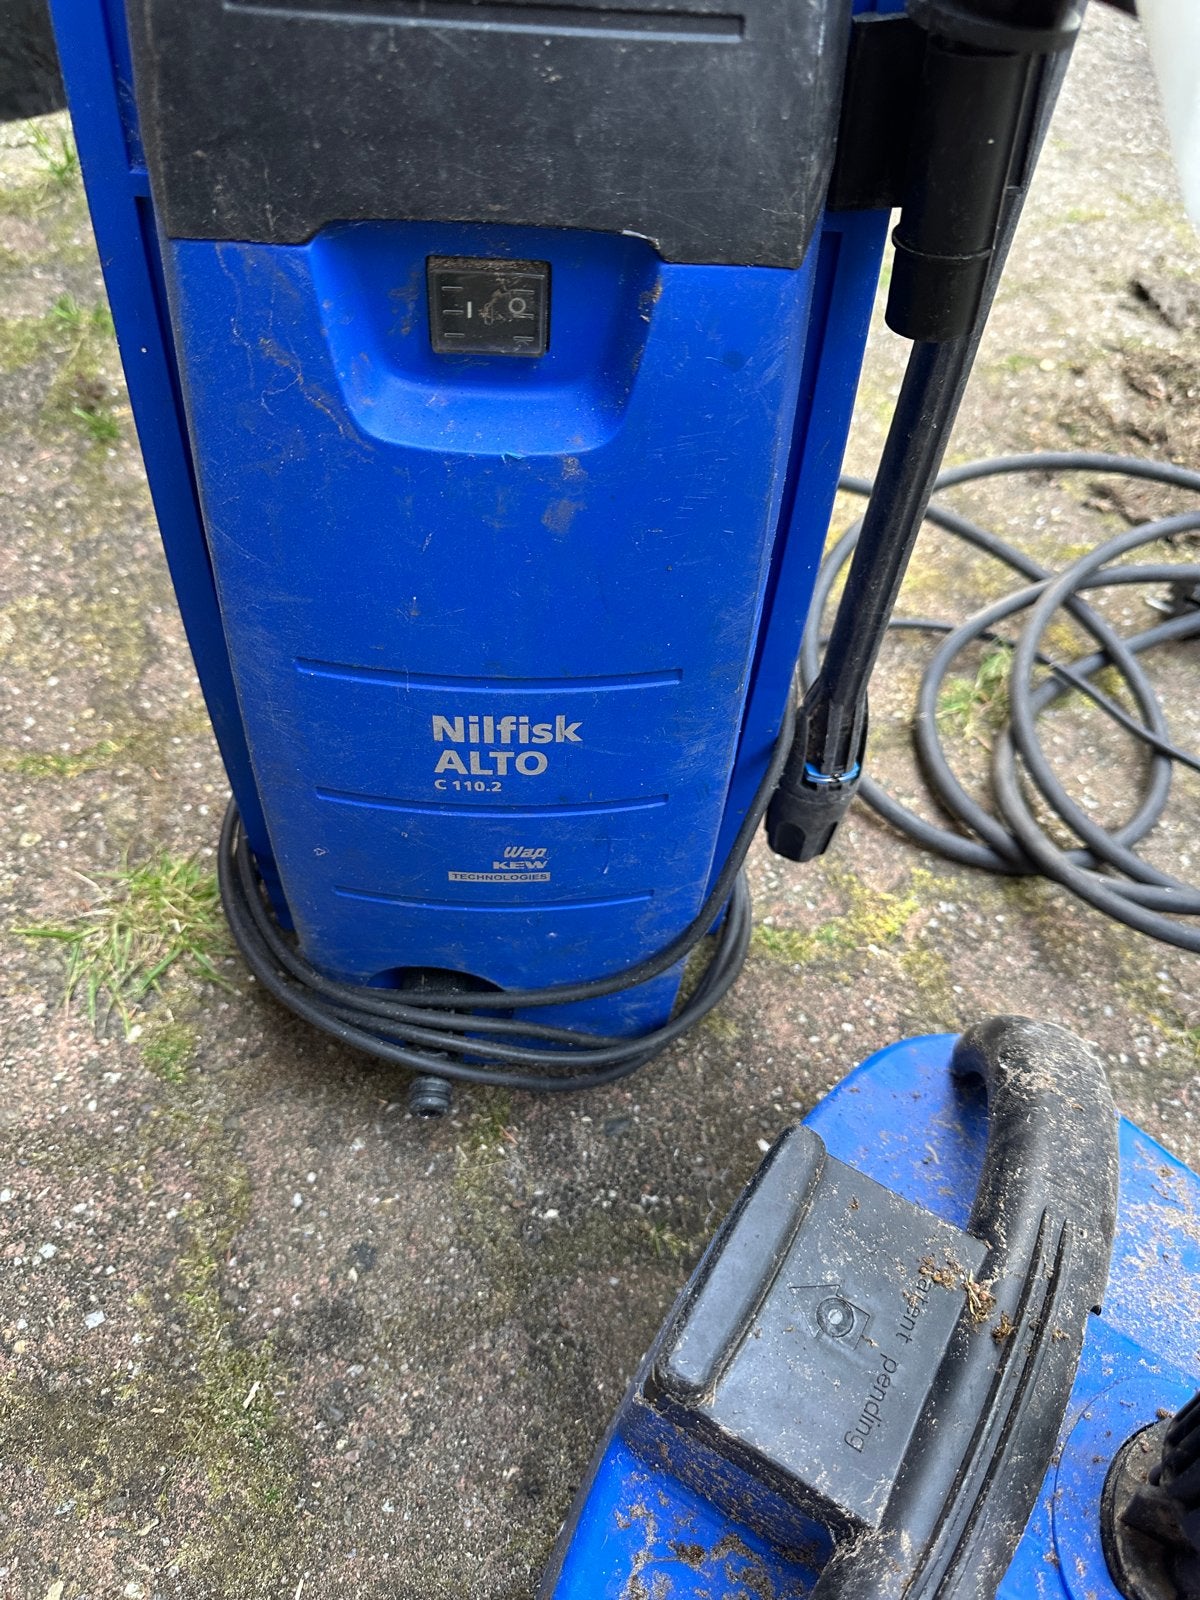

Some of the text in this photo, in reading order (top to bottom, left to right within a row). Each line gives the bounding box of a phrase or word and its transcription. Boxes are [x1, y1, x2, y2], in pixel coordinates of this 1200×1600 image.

[432, 715, 583, 744] Nilfisk
[434, 749, 548, 776] ALTO
[434, 779, 502, 792] C 110.2
[503, 846, 547, 859] Wap
[492, 861, 548, 870] KEW
[451, 872, 548, 881] TECHNOLOGIES
[843, 1353, 899, 1453] pending
